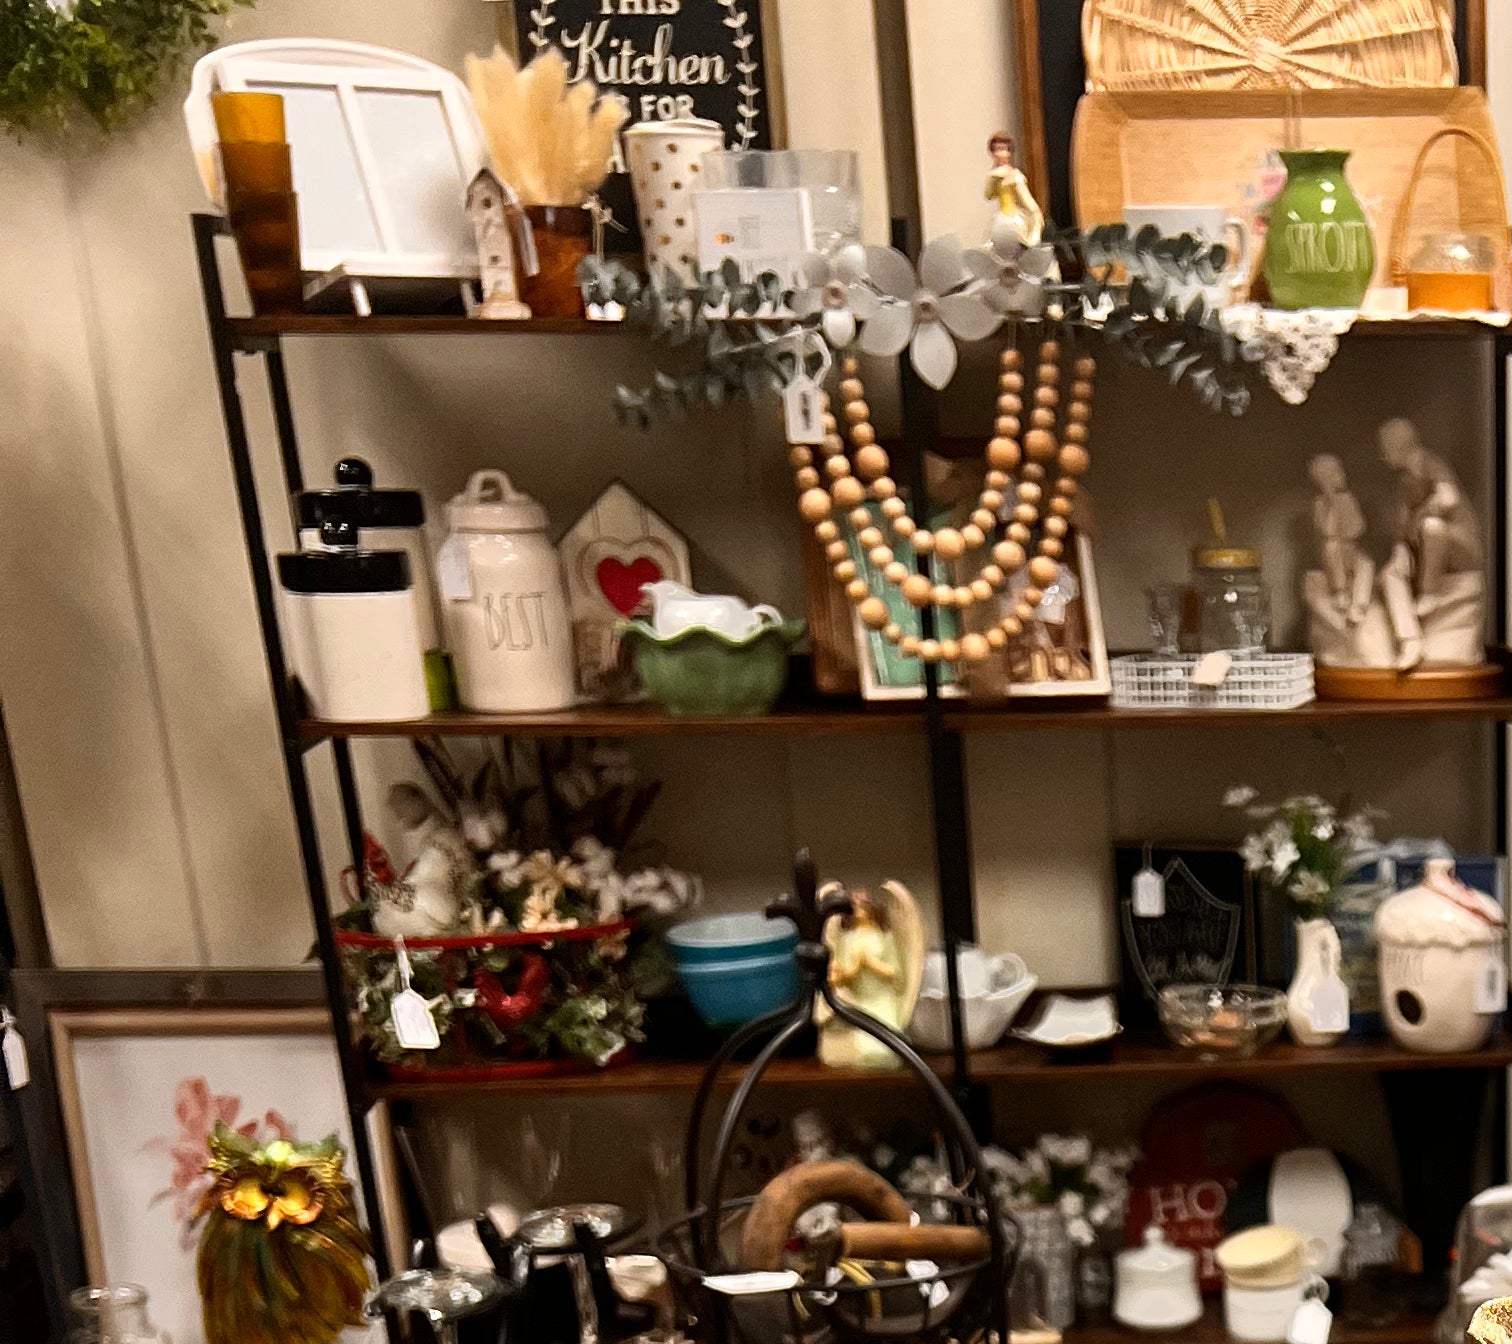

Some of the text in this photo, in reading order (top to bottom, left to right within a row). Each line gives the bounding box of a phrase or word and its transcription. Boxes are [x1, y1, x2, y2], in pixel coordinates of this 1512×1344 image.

[561, 18, 732, 85] Kitchen
[640, 94, 696, 120] FOR
[484, 591, 552, 651] BEST
